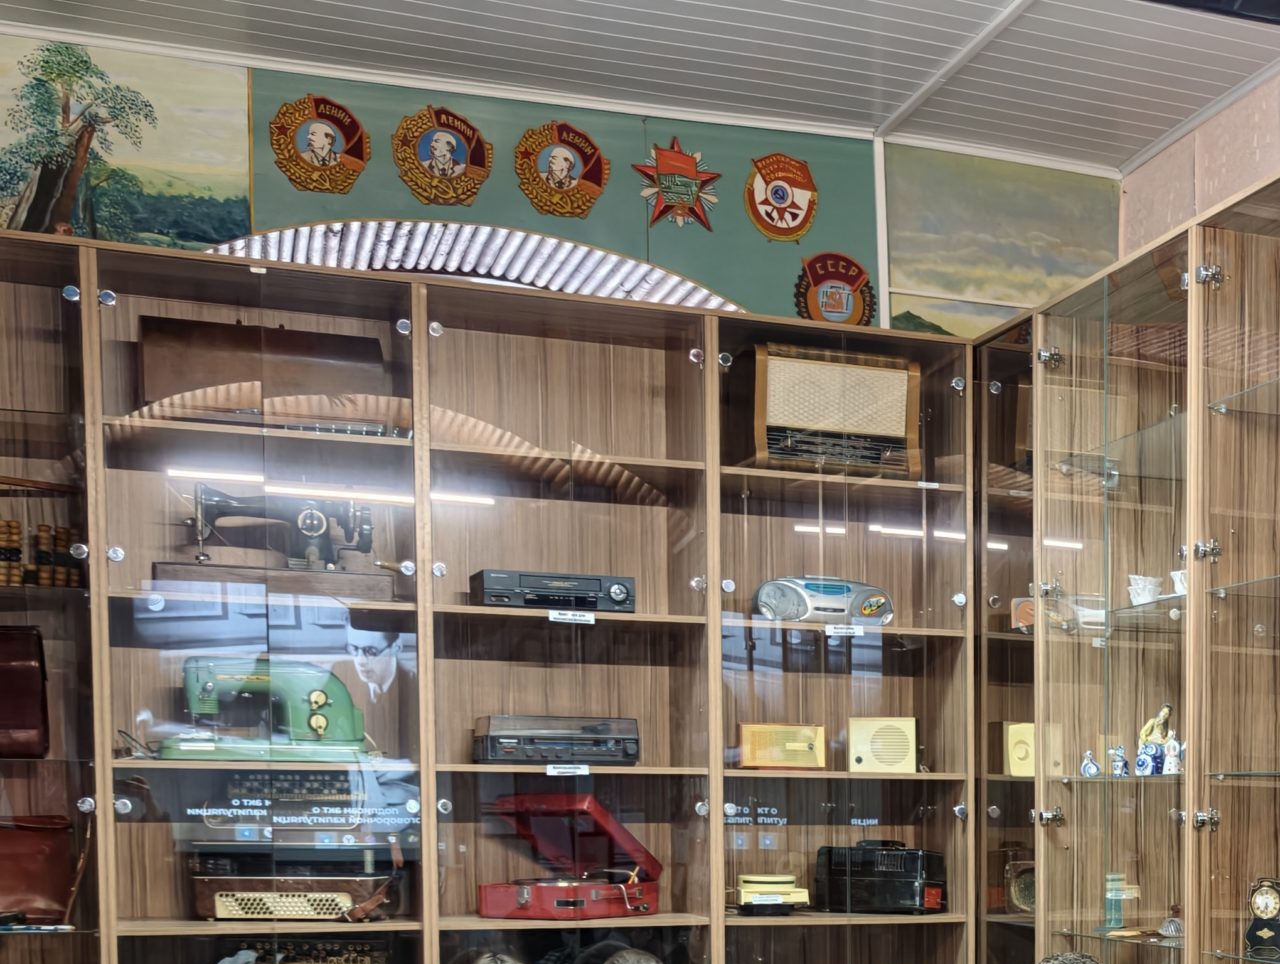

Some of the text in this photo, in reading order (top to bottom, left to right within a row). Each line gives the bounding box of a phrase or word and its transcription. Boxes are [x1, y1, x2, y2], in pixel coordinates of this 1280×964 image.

[317, 102, 351, 127] ЛЕНИН
[440, 113, 474, 138] ЛЕНИН
[561, 130, 595, 155] ЛЕНИН
[815, 260, 859, 276] СССР
